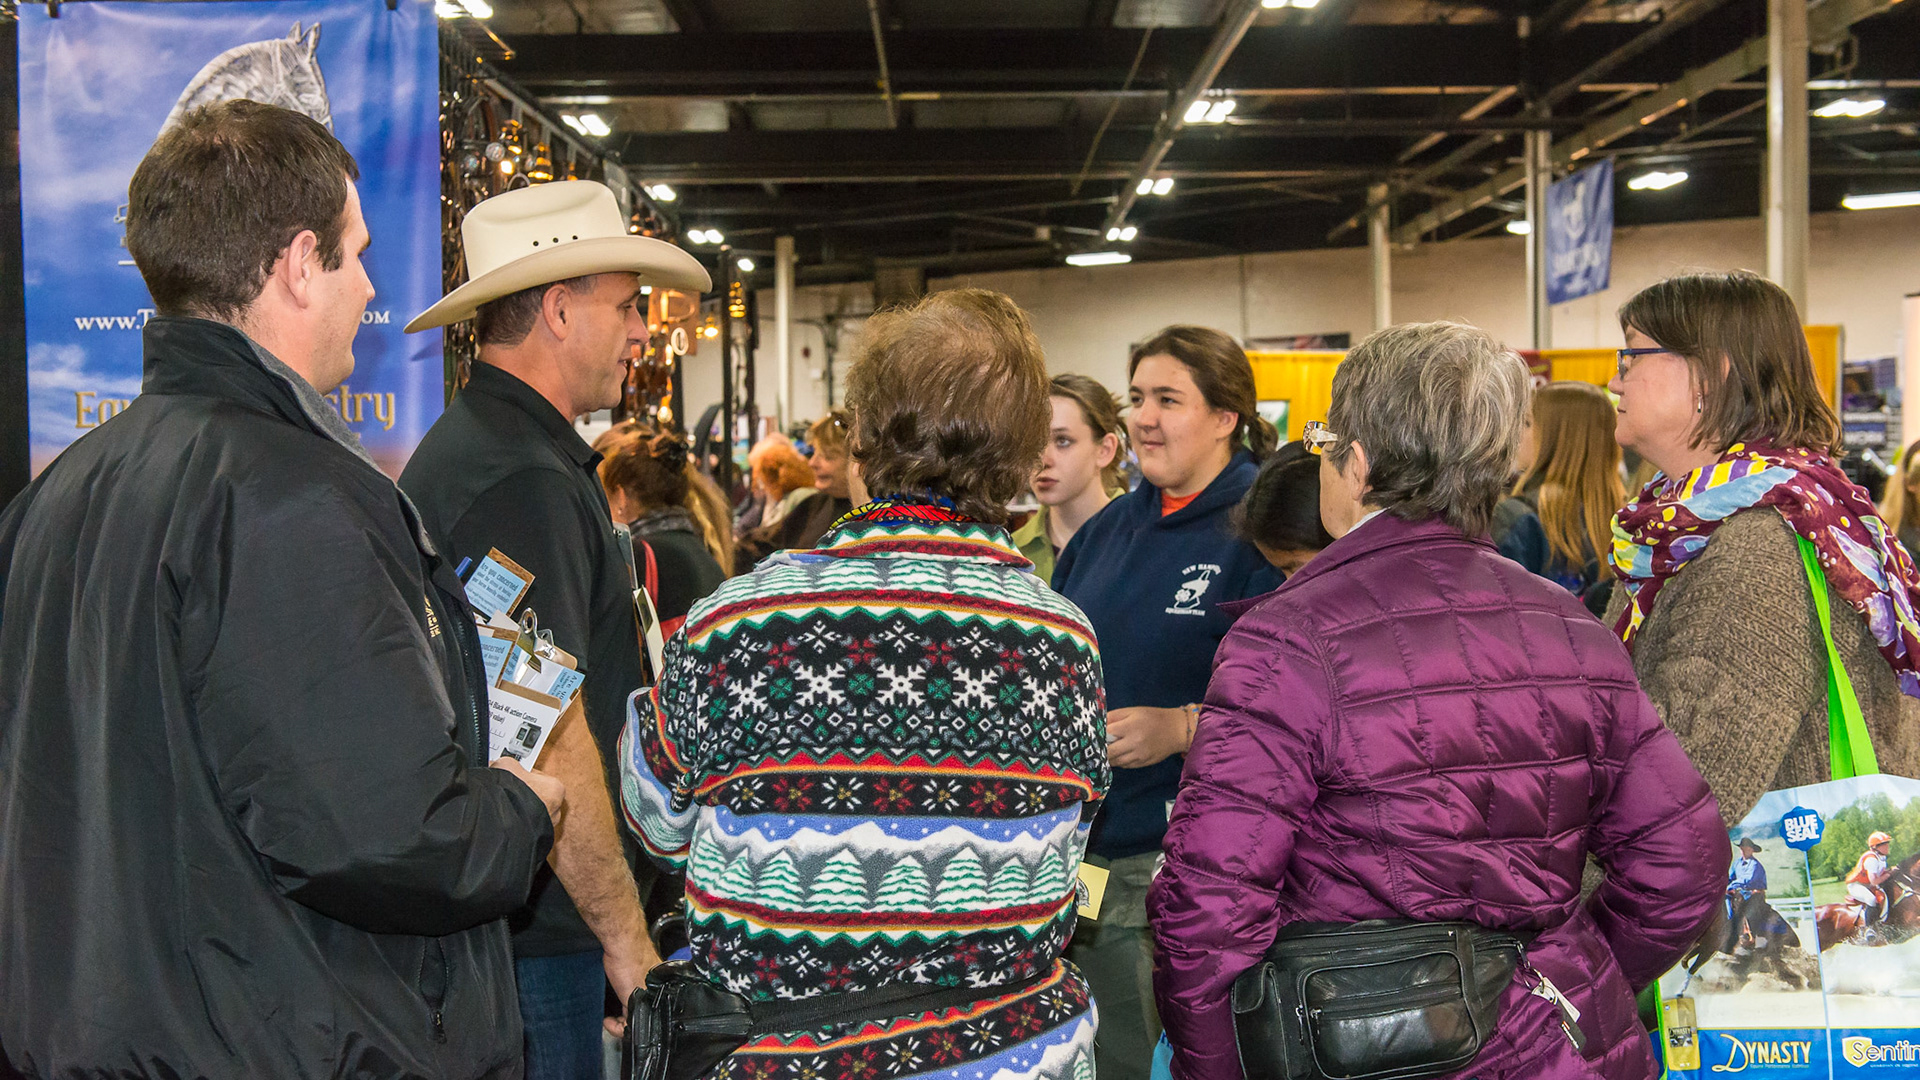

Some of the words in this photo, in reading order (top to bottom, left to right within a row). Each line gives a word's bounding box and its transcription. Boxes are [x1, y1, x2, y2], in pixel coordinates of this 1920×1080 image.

[74, 308, 154, 330] www.T
[361, 310, 390, 325] OM
[1182, 565, 1197, 575] NEW
[492, 701, 505, 711] Black
[509, 709, 523, 718] action
[522, 712, 538, 723] Camera
[1784, 814, 1818, 831] BLUE
[1786, 825, 1820, 843] SEAL
[1711, 1033, 1812, 1073] DYNASTY
